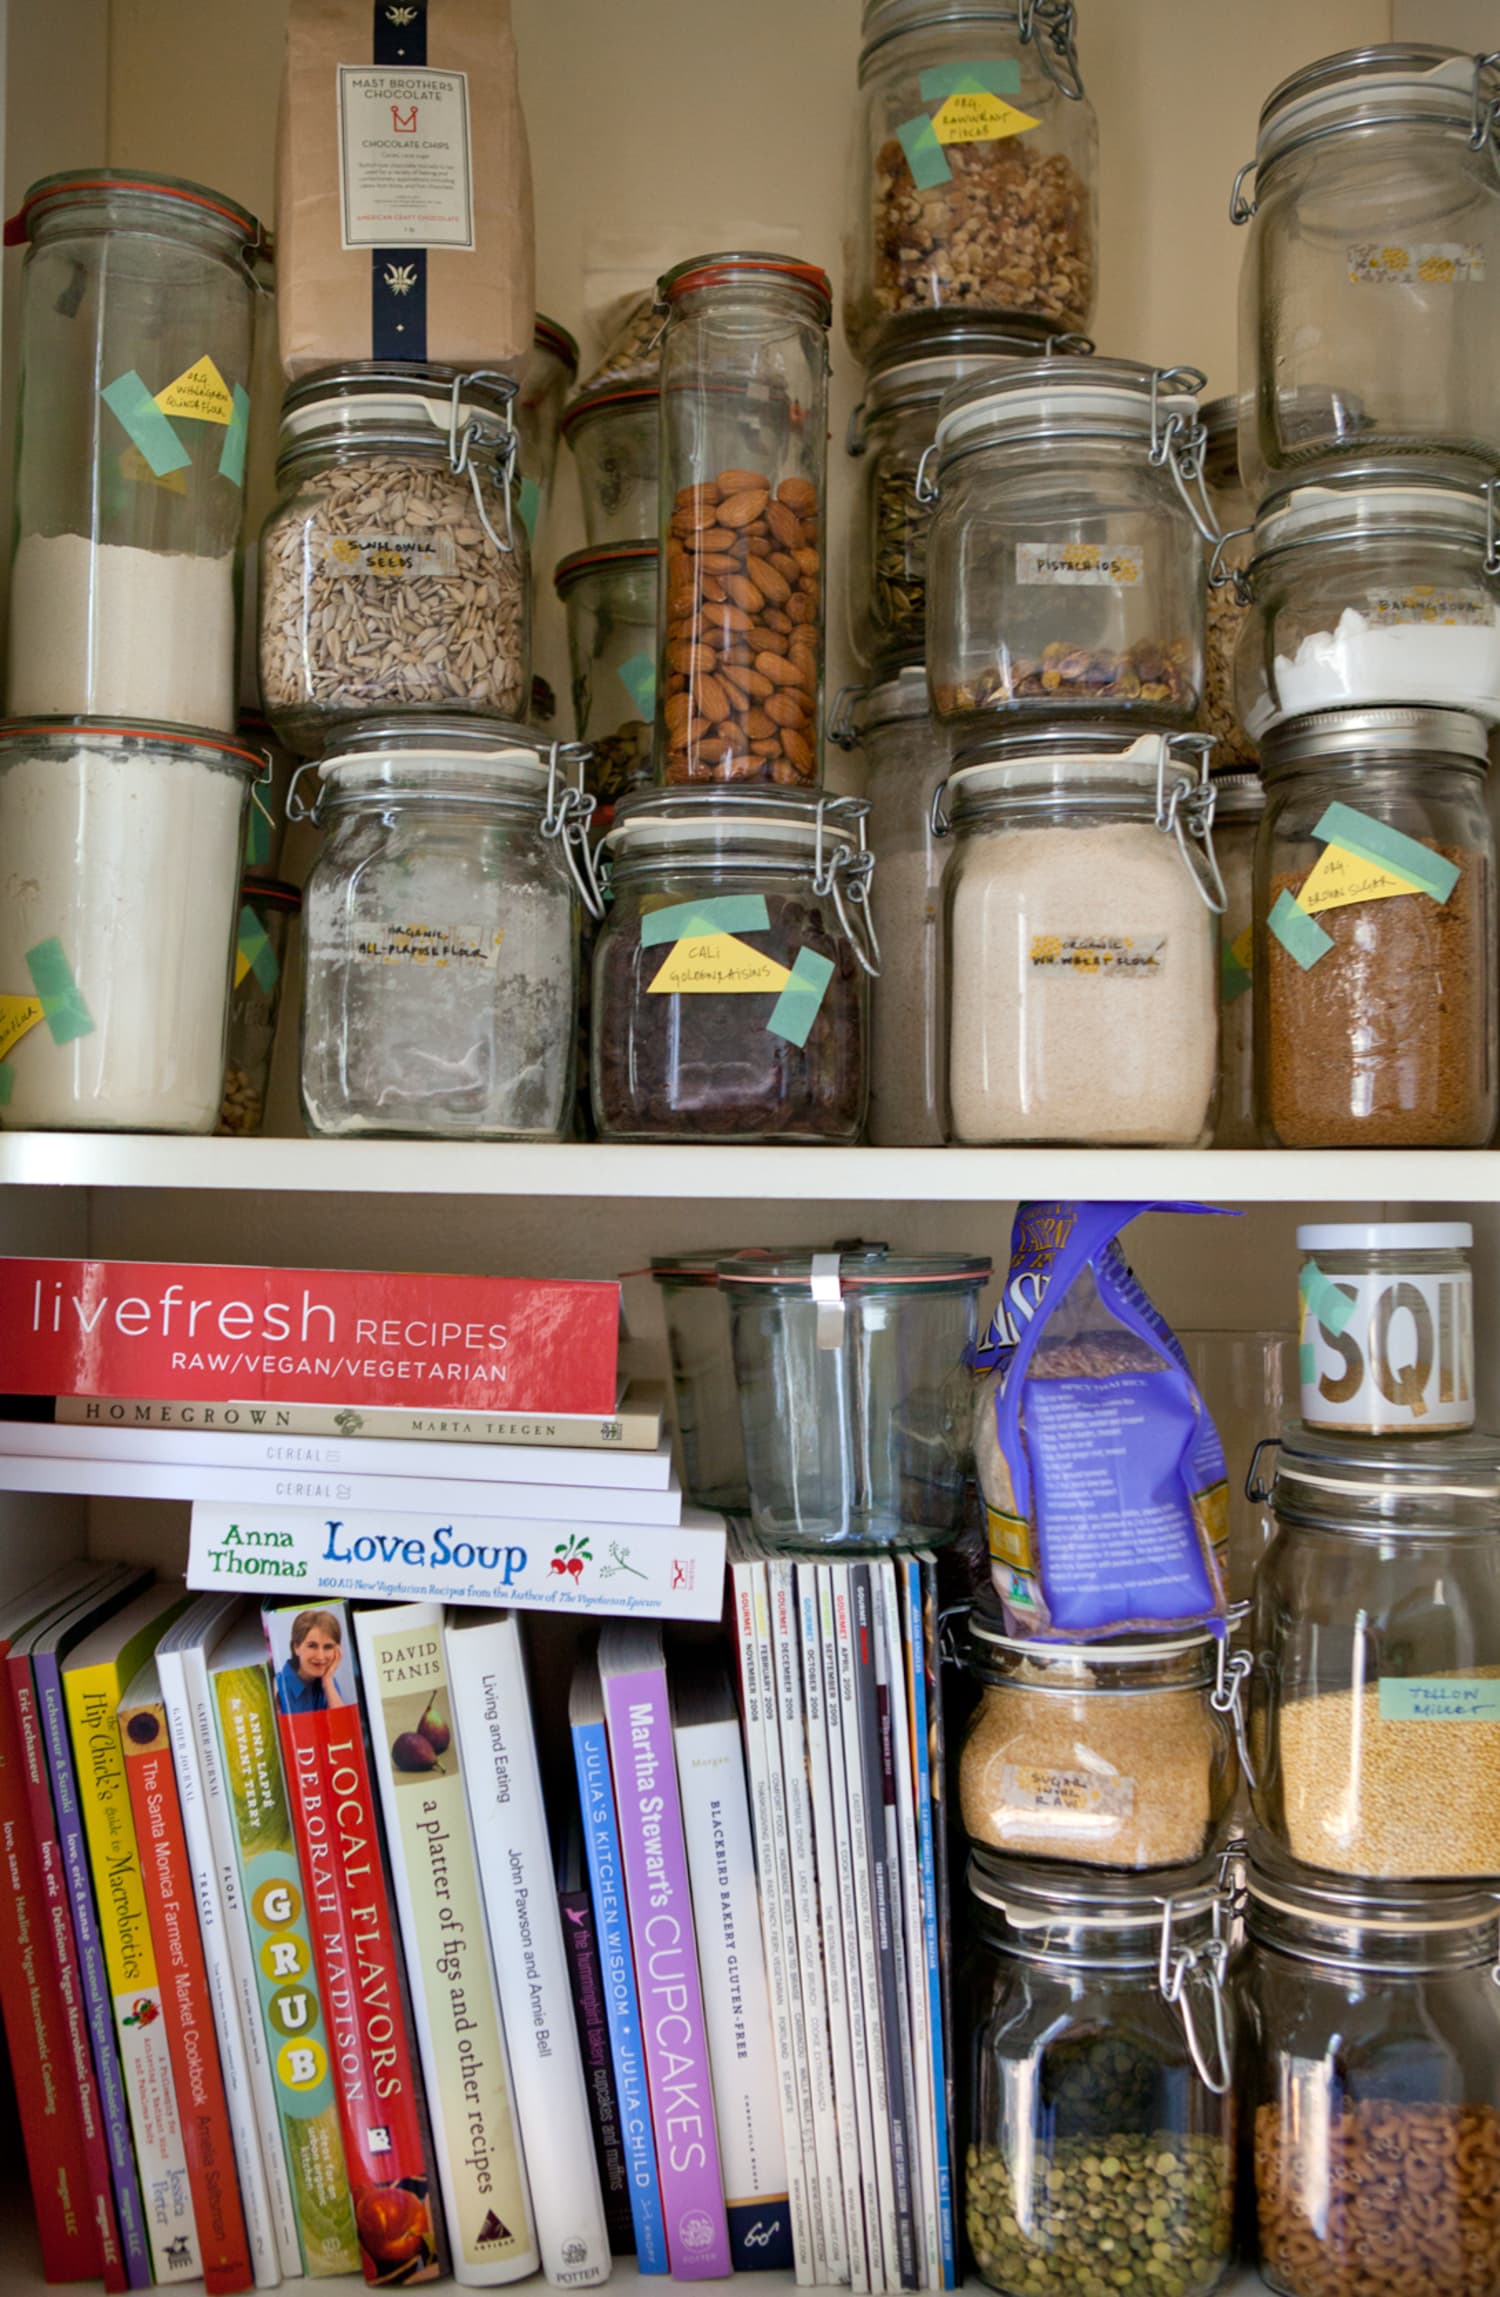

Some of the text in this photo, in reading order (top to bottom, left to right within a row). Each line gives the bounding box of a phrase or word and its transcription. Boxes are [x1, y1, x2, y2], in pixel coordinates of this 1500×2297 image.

[353, 79, 454, 92] MAST BROTHERS
[364, 89, 441, 100] CHOCOLATE
[362, 140, 449, 150] CHOCOLATE CHIPS
[348, 540, 436, 552] SUNFLOWER
[366, 556, 412, 568] SEEDS
[1038, 560, 1121, 572] PISTACHIOS
[1348, 876, 1396, 897] SUGAR
[388, 926, 447, 938] ORGANIC
[1062, 941, 1122, 950] ORGANIC
[32, 1279, 508, 1350] livefresh RECIPES
[172, 1352, 506, 1382] RAW/VEGAN/VEGETARIAN
[86, 1403, 556, 1436] HOMEGROWN MARTA TEEGEN
[266, 1446, 321, 1462] CEREAL
[276, 1482, 331, 1498] CEREAL
[208, 1549, 308, 1578] Thomas
[222, 1524, 294, 1548] Anna
[382, 1642, 438, 1664] DAVID
[384, 1660, 440, 1682] TANIS
[740, 1592, 758, 1721] GOURMET NOVEMBER 2008
[776, 1590, 794, 1720] GOURMET DECEMBER 2008
[803, 1597, 819, 1719] GOURMET OCTOBER 2008
[836, 1594, 852, 1701] GOURMET APRIL 2009
[81, 1692, 108, 1728] Hip
[759, 1644, 774, 1719] FEBRUARY 2009
[824, 1642, 838, 1726] SEPTEMBER 2009
[88, 1732, 118, 1801] Chick's
[141, 1760, 161, 1792] The
[229, 1697, 262, 1828] & BRYANT TERRY
[247, 1711, 274, 1808] ANNA LAPPÉ
[1032, 1773, 1087, 1788] SUGAR
[146, 1793, 168, 1838] Santa
[171, 1707, 213, 1925] GATHER JOURNAL TRACES
[196, 1702, 236, 1910] GATHER JOURNAL FLOAT
[1036, 1796, 1078, 1808] RAW
[111, 1840, 122, 1853] to
[153, 1841, 177, 1898] Monica
[478, 1674, 551, 2057] Living and Eating John Pawson and Annie Bell
[18, 1688, 96, 2138] Eric Lechasseur love, eric Delicious Vegan Macrobiotic Desserts
[44, 1688, 127, 2167] Lechasseur & Suzuki love, eric & sanae Seasonal Vegan Macrobiotic Cuisine
[106, 1853, 142, 1980] Macrobiotics
[163, 1901, 188, 1969] Farmers'
[297, 1747, 364, 2101] DEBORAH MADISON
[328, 1740, 402, 2099] LOCAL FLAVORS
[627, 1702, 706, 2172] Martha Stewart's CUPCAKES
[710, 1800, 747, 2059] BLACKBIRD BAKERY GLUTEN-FREE
[1, 1821, 58, 2115] love, sanae Healing Vegan Macrobiotic Cooking
[583, 1739, 650, 2188] JULIA'S KITCHEN WISDOM JULIA CHILD
[173, 1972, 196, 2026] Market
[416, 1799, 499, 2196] a platter of figs and other recipes
[182, 2030, 208, 2106] Cookbook
[573, 1930, 624, 2191] the hummingbird bakery cupcakes and muffins
[195, 2116, 217, 2165] Amelia
[298, 2146, 315, 2190] kitchen
[307, 2127, 328, 2206] urban organic
[317, 2128, 336, 2199] ideas for an
[151, 2179, 173, 2226] Porter
[166, 2168, 190, 2216] Jessica
[203, 2170, 229, 2241] Saltsman
[556, 2266, 600, 2283] POTTER
